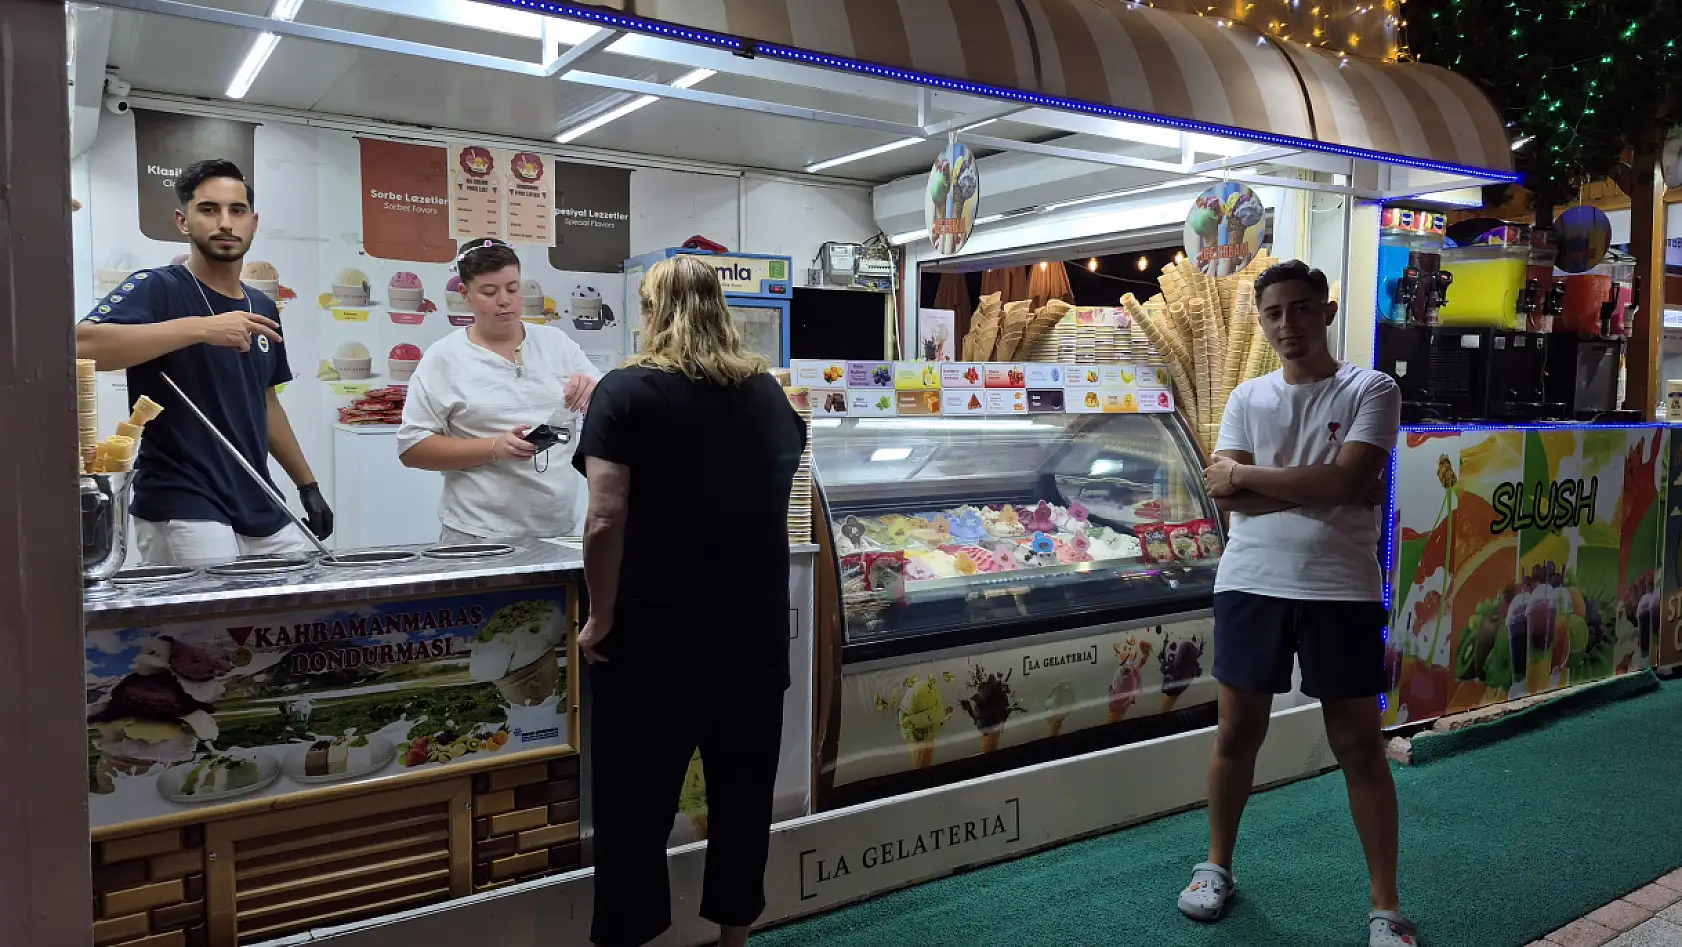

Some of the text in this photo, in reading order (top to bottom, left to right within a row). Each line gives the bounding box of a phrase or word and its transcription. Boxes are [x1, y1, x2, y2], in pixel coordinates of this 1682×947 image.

[370, 188, 403, 201] Sorbe
[383, 202, 411, 212] Sorbet
[555, 207, 587, 218] pesiyal
[1490, 476, 1598, 534] SLUSH
[254, 605, 484, 649] KAHRAMANMARAŞ
[292, 637, 456, 675] DONDURMASI
[1029, 651, 1093, 670] LA GELATERIA
[817, 814, 1007, 883] LA GELATERIA
